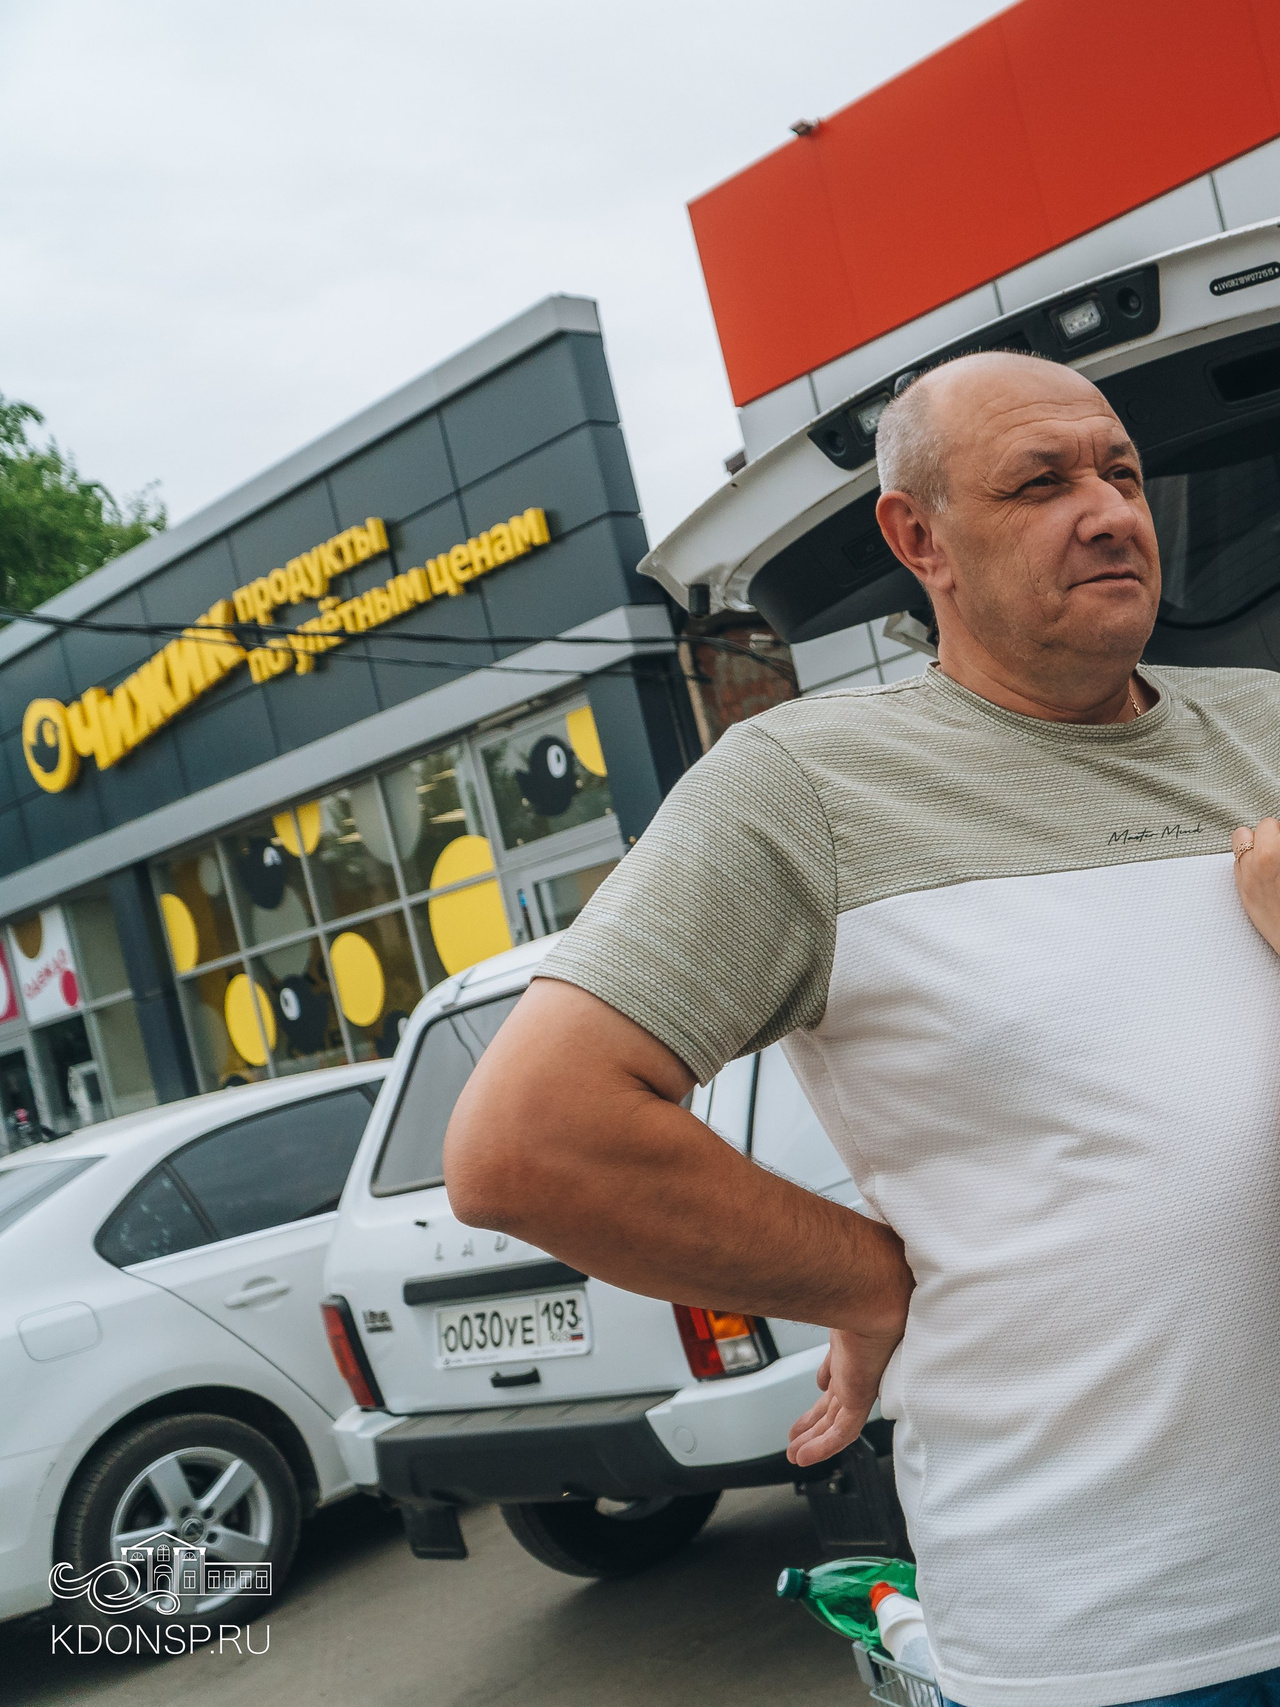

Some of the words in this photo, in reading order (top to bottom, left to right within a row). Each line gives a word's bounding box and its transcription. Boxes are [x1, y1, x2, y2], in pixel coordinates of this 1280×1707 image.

[232, 516, 390, 626] продукты
[247, 637, 295, 684] по
[286, 566, 433, 676] улётным
[425, 506, 551, 597] ценам
[1160, 822, 1205, 839] Mind
[434, 1234, 510, 1262] LAD
[541, 1299, 579, 1332] 193
